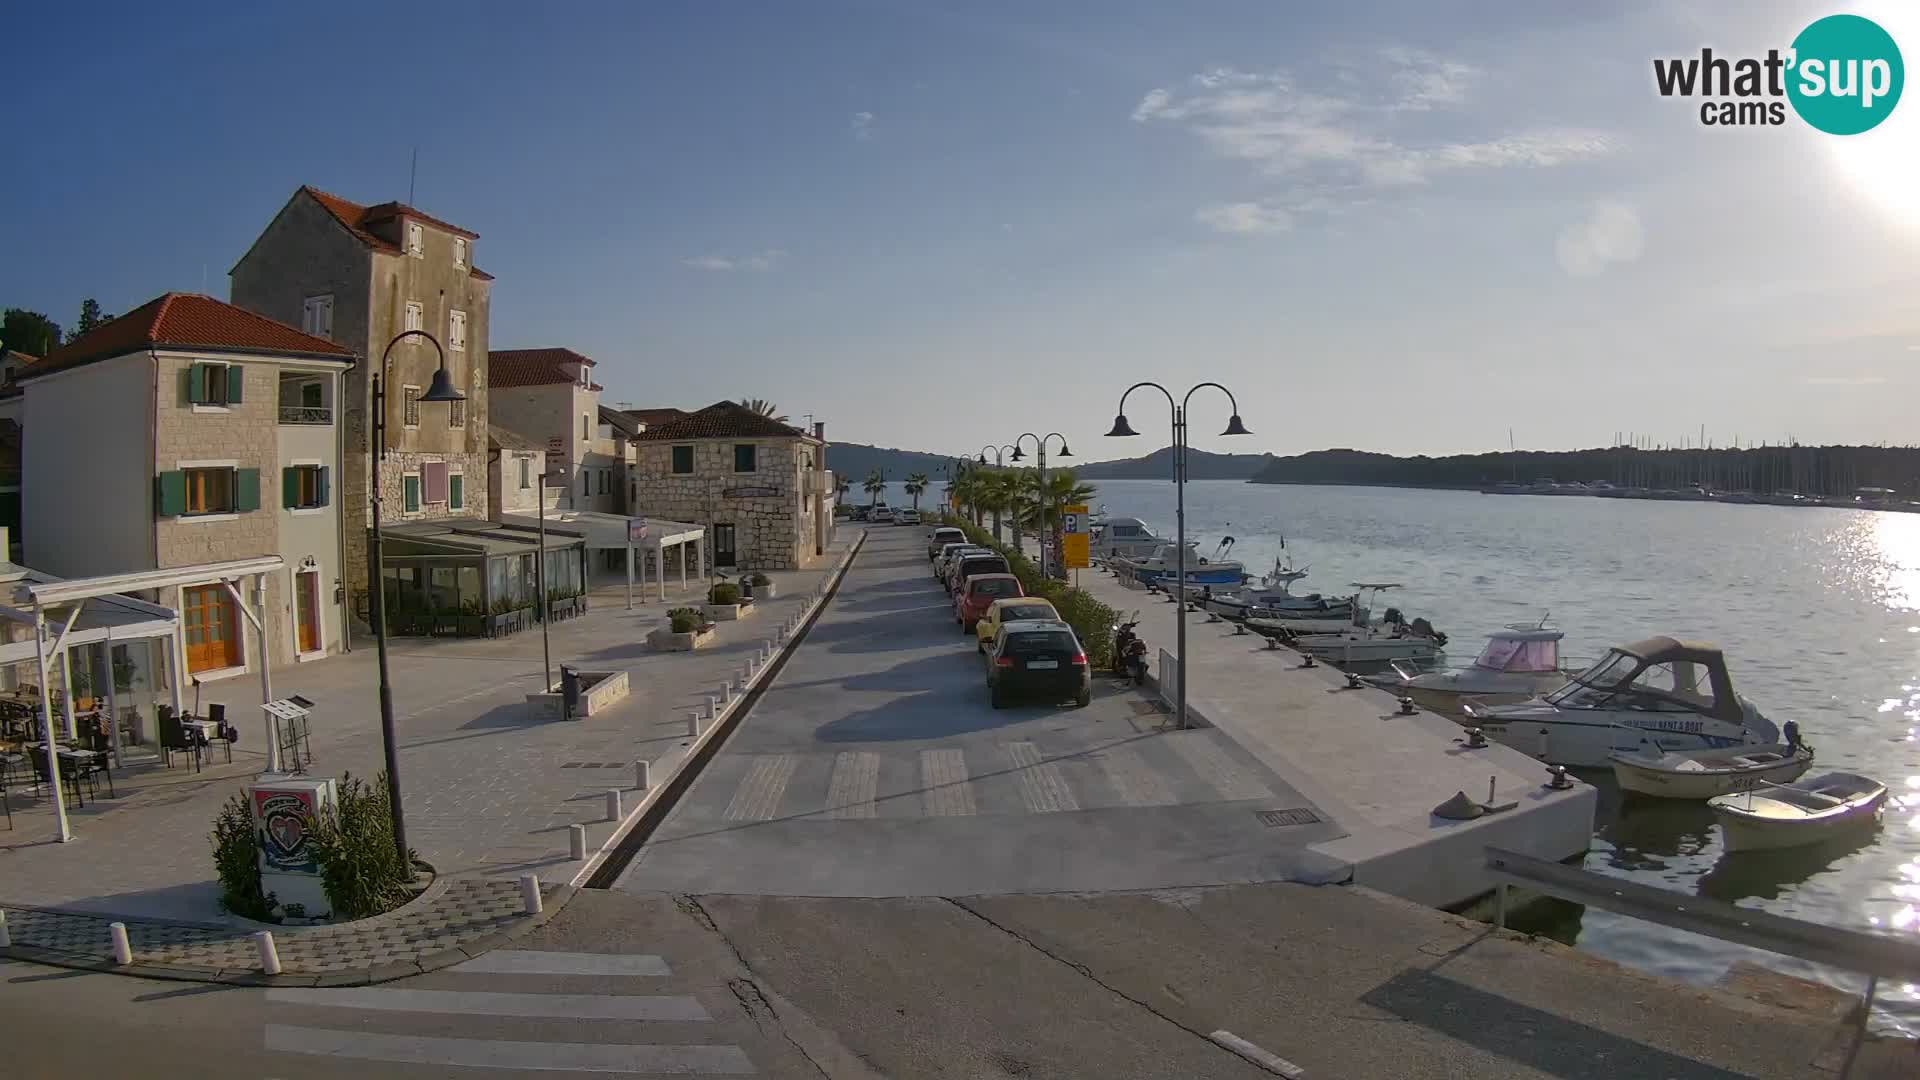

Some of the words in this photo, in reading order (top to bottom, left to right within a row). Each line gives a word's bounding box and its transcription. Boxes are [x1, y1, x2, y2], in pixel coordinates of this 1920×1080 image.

[1065, 514, 1076, 531] P
[1658, 720, 1678, 730] RENT
[1685, 721, 1704, 733] BOAT
